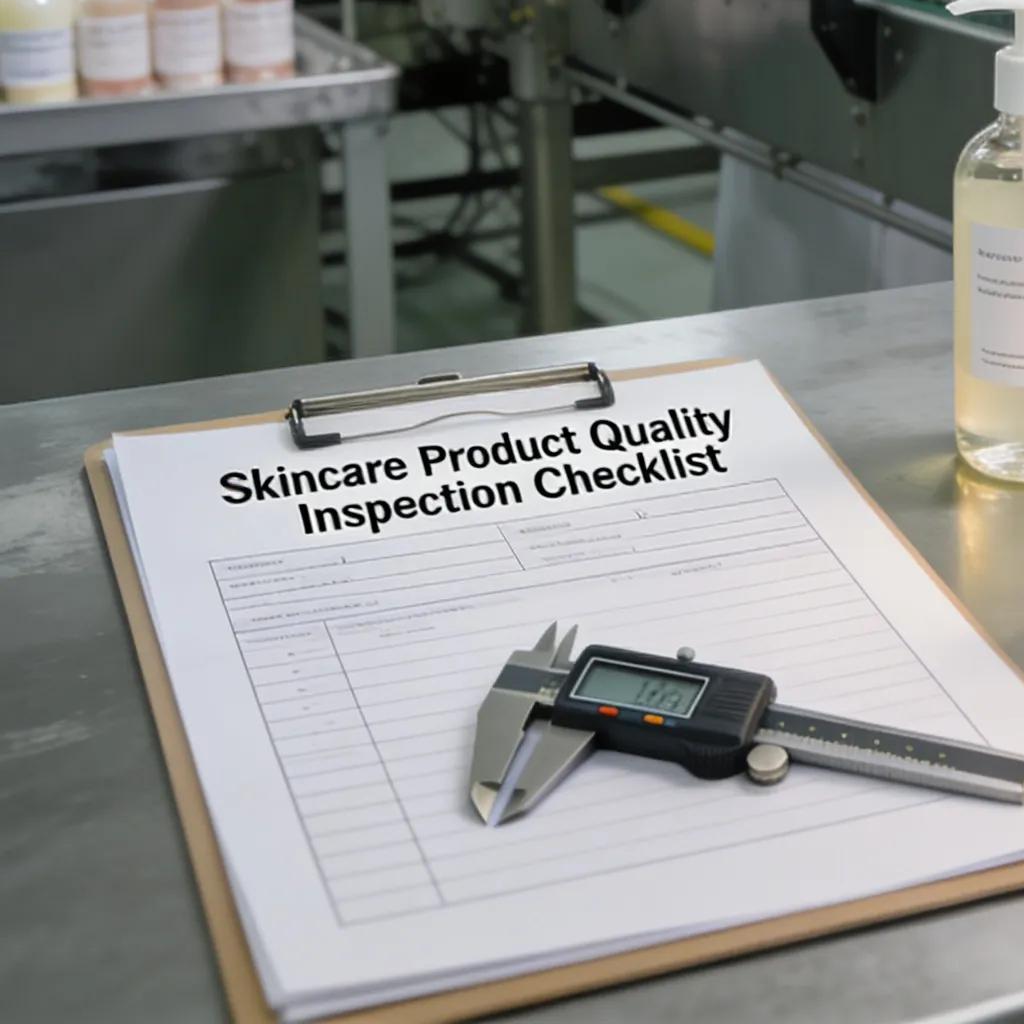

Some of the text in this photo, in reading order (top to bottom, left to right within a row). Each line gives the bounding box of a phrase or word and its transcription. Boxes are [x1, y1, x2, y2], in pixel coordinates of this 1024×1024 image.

[219, 407, 732, 505] Skincare Product Quality
[298, 444, 728, 535] Inspection Checklist
